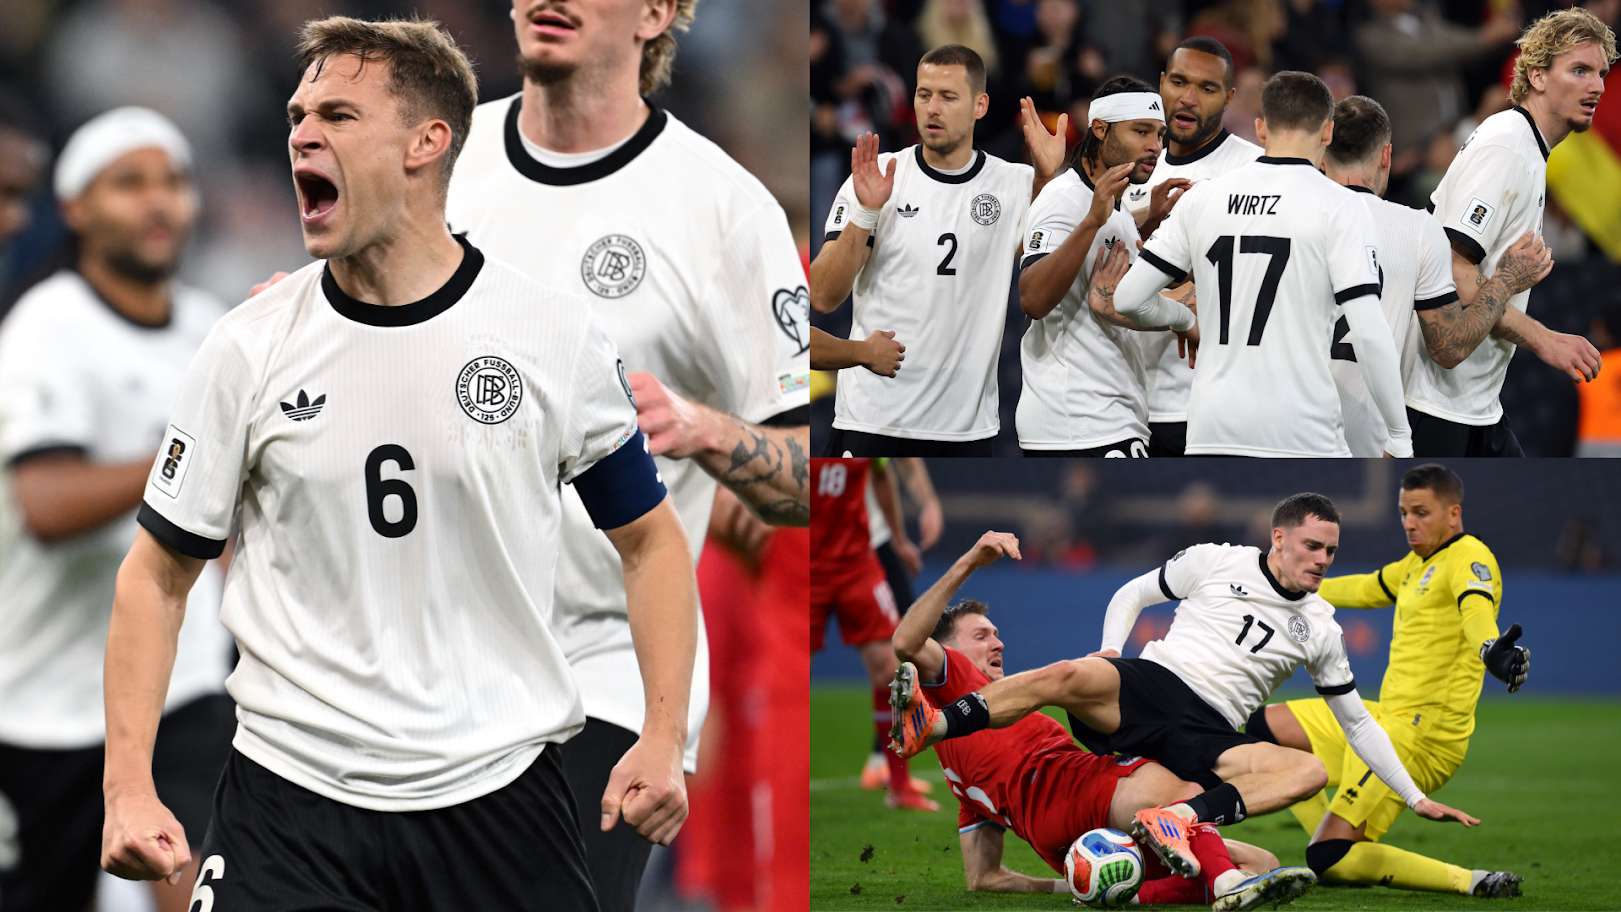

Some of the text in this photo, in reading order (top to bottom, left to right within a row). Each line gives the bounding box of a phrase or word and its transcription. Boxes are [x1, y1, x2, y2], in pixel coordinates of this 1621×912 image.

[1227, 194, 1282, 215] WIRTZ
[936, 232, 958, 276] 2
[1205, 235, 1291, 346] 17
[460, 362, 480, 413] DEUTSCHER
[364, 443, 418, 538] 6
[818, 462, 848, 498] 18
[1235, 614, 1275, 654] 17
[187, 854, 226, 912] 6
